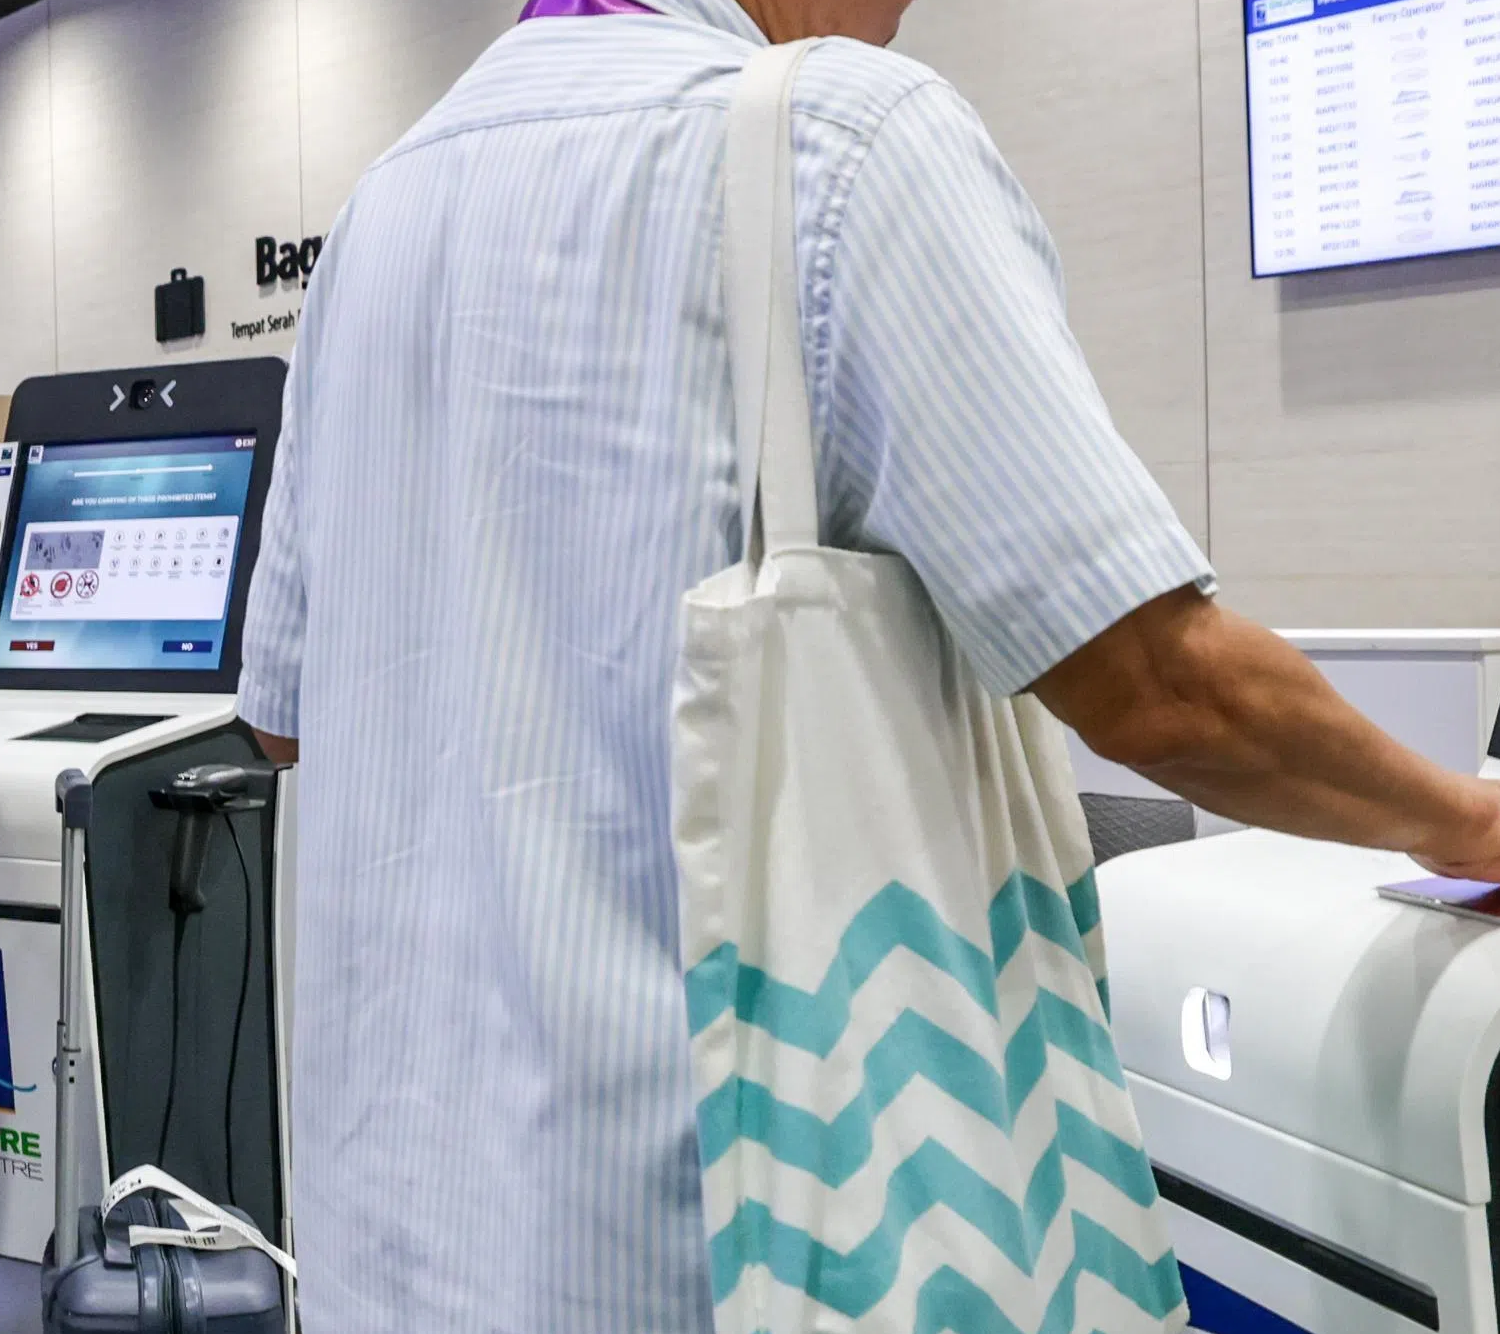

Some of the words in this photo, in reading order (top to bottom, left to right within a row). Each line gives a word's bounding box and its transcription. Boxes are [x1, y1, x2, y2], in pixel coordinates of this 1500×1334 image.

[255, 235, 323, 290] Bag
[231, 318, 265, 341] Tempat
[267, 309, 295, 333] Serah
[181, 642, 194, 652] NO
